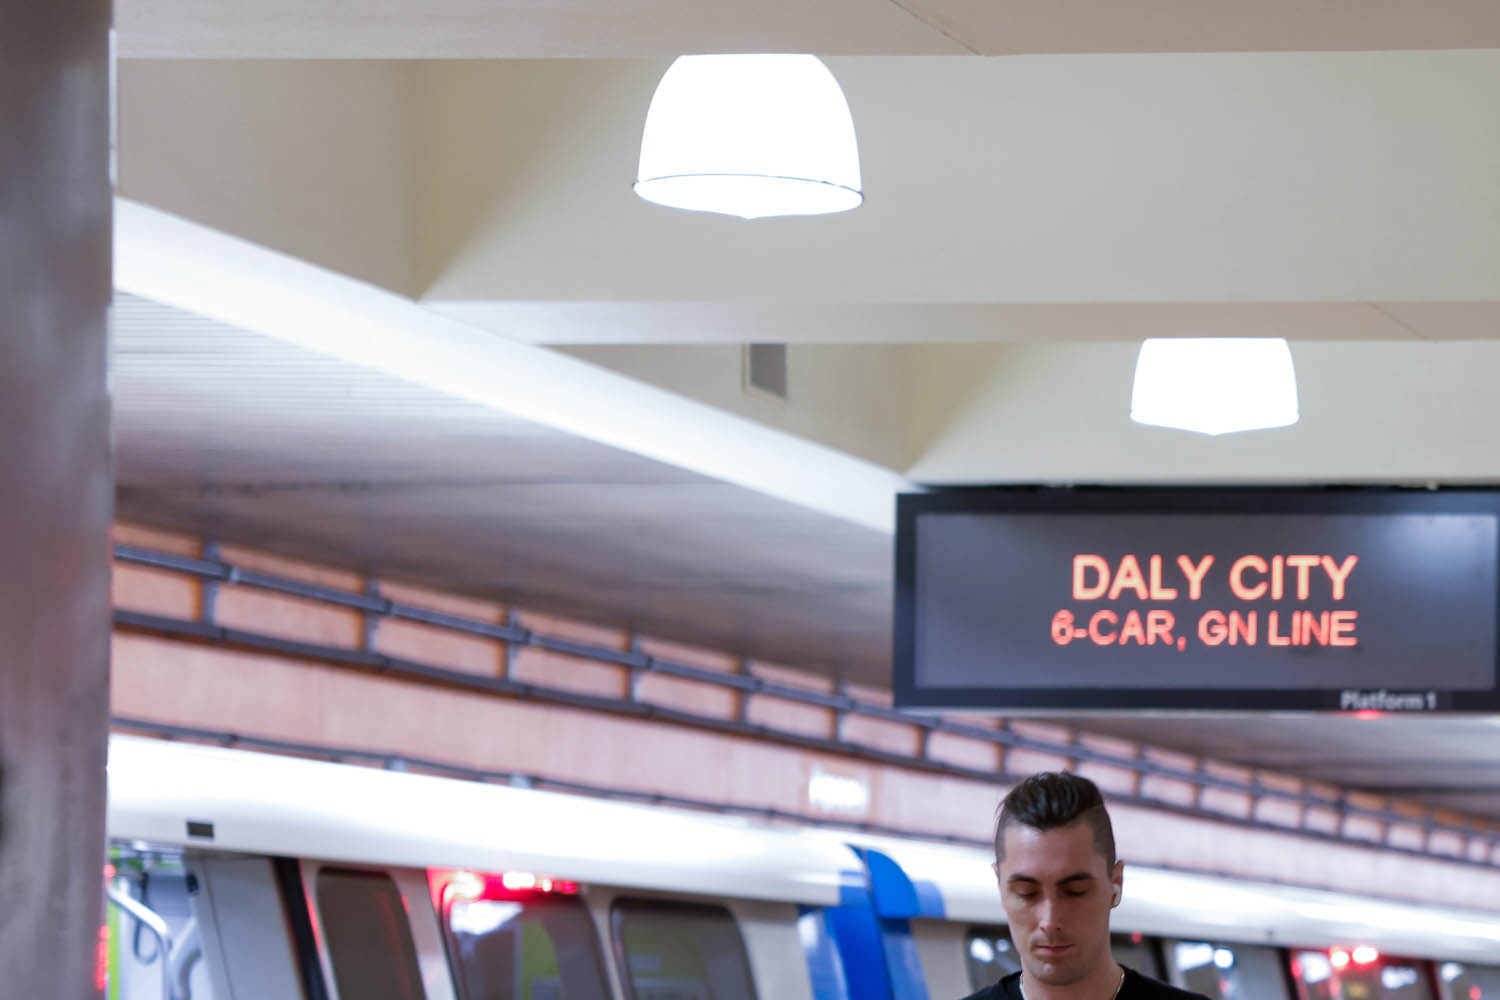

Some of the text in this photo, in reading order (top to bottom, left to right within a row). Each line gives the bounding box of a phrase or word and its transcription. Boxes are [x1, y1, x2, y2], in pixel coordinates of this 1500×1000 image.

[1072, 554, 1359, 601] DALY CITY
[1051, 609, 1359, 651] 6-CAR, GN LINE
[1341, 690, 1422, 710] Platform
